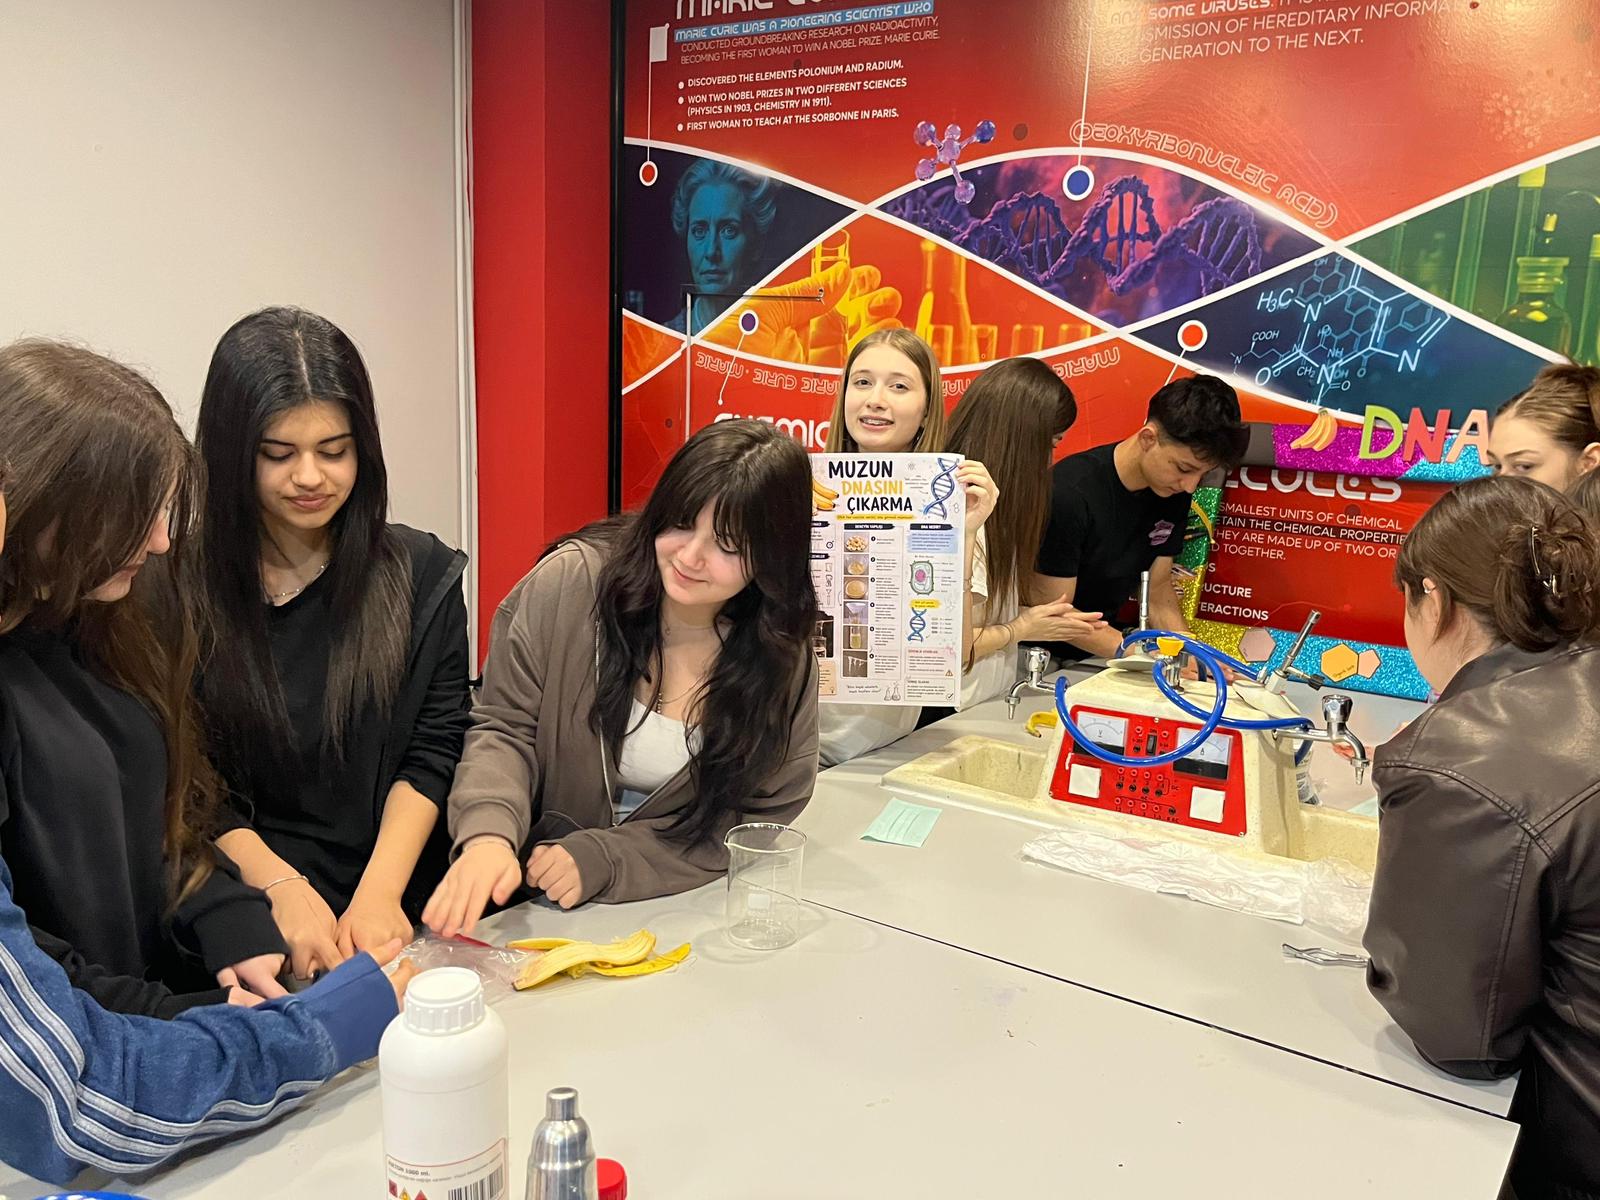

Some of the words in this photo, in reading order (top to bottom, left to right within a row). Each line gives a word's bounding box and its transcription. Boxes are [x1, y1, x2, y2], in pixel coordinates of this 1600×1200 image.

[676, 28, 707, 40] MARIE
[711, 25, 739, 36] CURIE
[742, 22, 766, 32] WAS
[770, 20, 777, 30] A
[780, 13, 841, 28] PIONEERING
[846, 6, 901, 21] SCIENTIST
[1148, 4, 1196, 20] SOME
[1226, 17, 1249, 34] OF
[1253, 6, 1361, 30] HEREDITARY
[681, 39, 730, 52] CONDUCTED
[732, 31, 807, 46] GROUNDBREAKING
[808, 26, 852, 38] RESEARCH
[854, 24, 868, 34] ON
[870, 16, 938, 31] RADIOACTIVITY,
[1139, 40, 1242, 63] GENERATION
[1248, 36, 1270, 53] TO
[1276, 33, 1309, 50] THE
[1314, 28, 1364, 47] NEXT.
[681, 52, 720, 64] BECOMING
[722, 50, 736, 60] THE
[738, 48, 756, 58] FIRST
[758, 46, 790, 56] WOMAN
[792, 44, 803, 53] TO
[804, 42, 822, 52] WIN
[822, 41, 828, 50] A
[830, 38, 856, 49] NOBEL
[885, 33, 911, 44] MARIE
[688, 75, 736, 87] DISCOVERED
[738, 74, 754, 82] THE
[756, 70, 796, 81] ELEMENTS
[798, 65, 843, 78] POLONIUM
[844, 63, 864, 73] AND
[866, 60, 904, 71] RADIUM.
[688, 95, 707, 104] WON
[708, 93, 727, 102] TWO
[728, 91, 754, 100] NOBEL
[756, 88, 784, 98] PRIZES
[784, 87, 794, 96] IN
[795, 86, 815, 95] TWO
[816, 82, 862, 94] DIFFERENT
[863, 78, 907, 90] SCIENCES
[688, 105, 722, 117] (PHYSICS
[724, 104, 732, 113] IN
[734, 104, 752, 113] 1903,
[754, 100, 800, 111] CHEMISTRY
[802, 98, 810, 107] IN
[812, 96, 832, 107] 1911).
[686, 122, 707, 130] FIRST
[708, 120, 740, 130] WOMAN
[742, 118, 752, 127] TO
[754, 116, 781, 126] TEACH
[782, 116, 793, 124] AT
[794, 114, 810, 124] THE
[812, 110, 860, 122] SORBONNE
[860, 110, 870, 119] IN
[872, 108, 899, 118] PARIS.
[1278, 183, 1338, 228] ACID)
[1304, 302, 1322, 323] N
[1252, 330, 1280, 341] COOH
[696, 352, 744, 378] MARIE
[1398, 348, 1420, 372] N
[752, 368, 797, 390] CURIE
[1255, 367, 1271, 386] O
[1359, 404, 1488, 466] DNA
[828, 460, 893, 478] MUZUN
[841, 480, 903, 495] DNASINI
[847, 496, 912, 514] ÇIKARMA
[1218, 502, 1276, 517] SMALLEST
[1280, 508, 1314, 522] UNITS
[1316, 512, 1334, 522] OF
[1336, 514, 1402, 530] CHEMICAL
[1249, 518, 1271, 530] THE
[1274, 522, 1336, 538] CHEMICAL
[1224, 544, 1286, 560] TOGETHER.
[1242, 532, 1264, 544] ARE
[1267, 535, 1302, 548] MADE
[1305, 540, 1322, 550] UP
[1324, 541, 1342, 552] OF
[1344, 543, 1374, 556] TWO
[1378, 548, 1396, 558] OR
